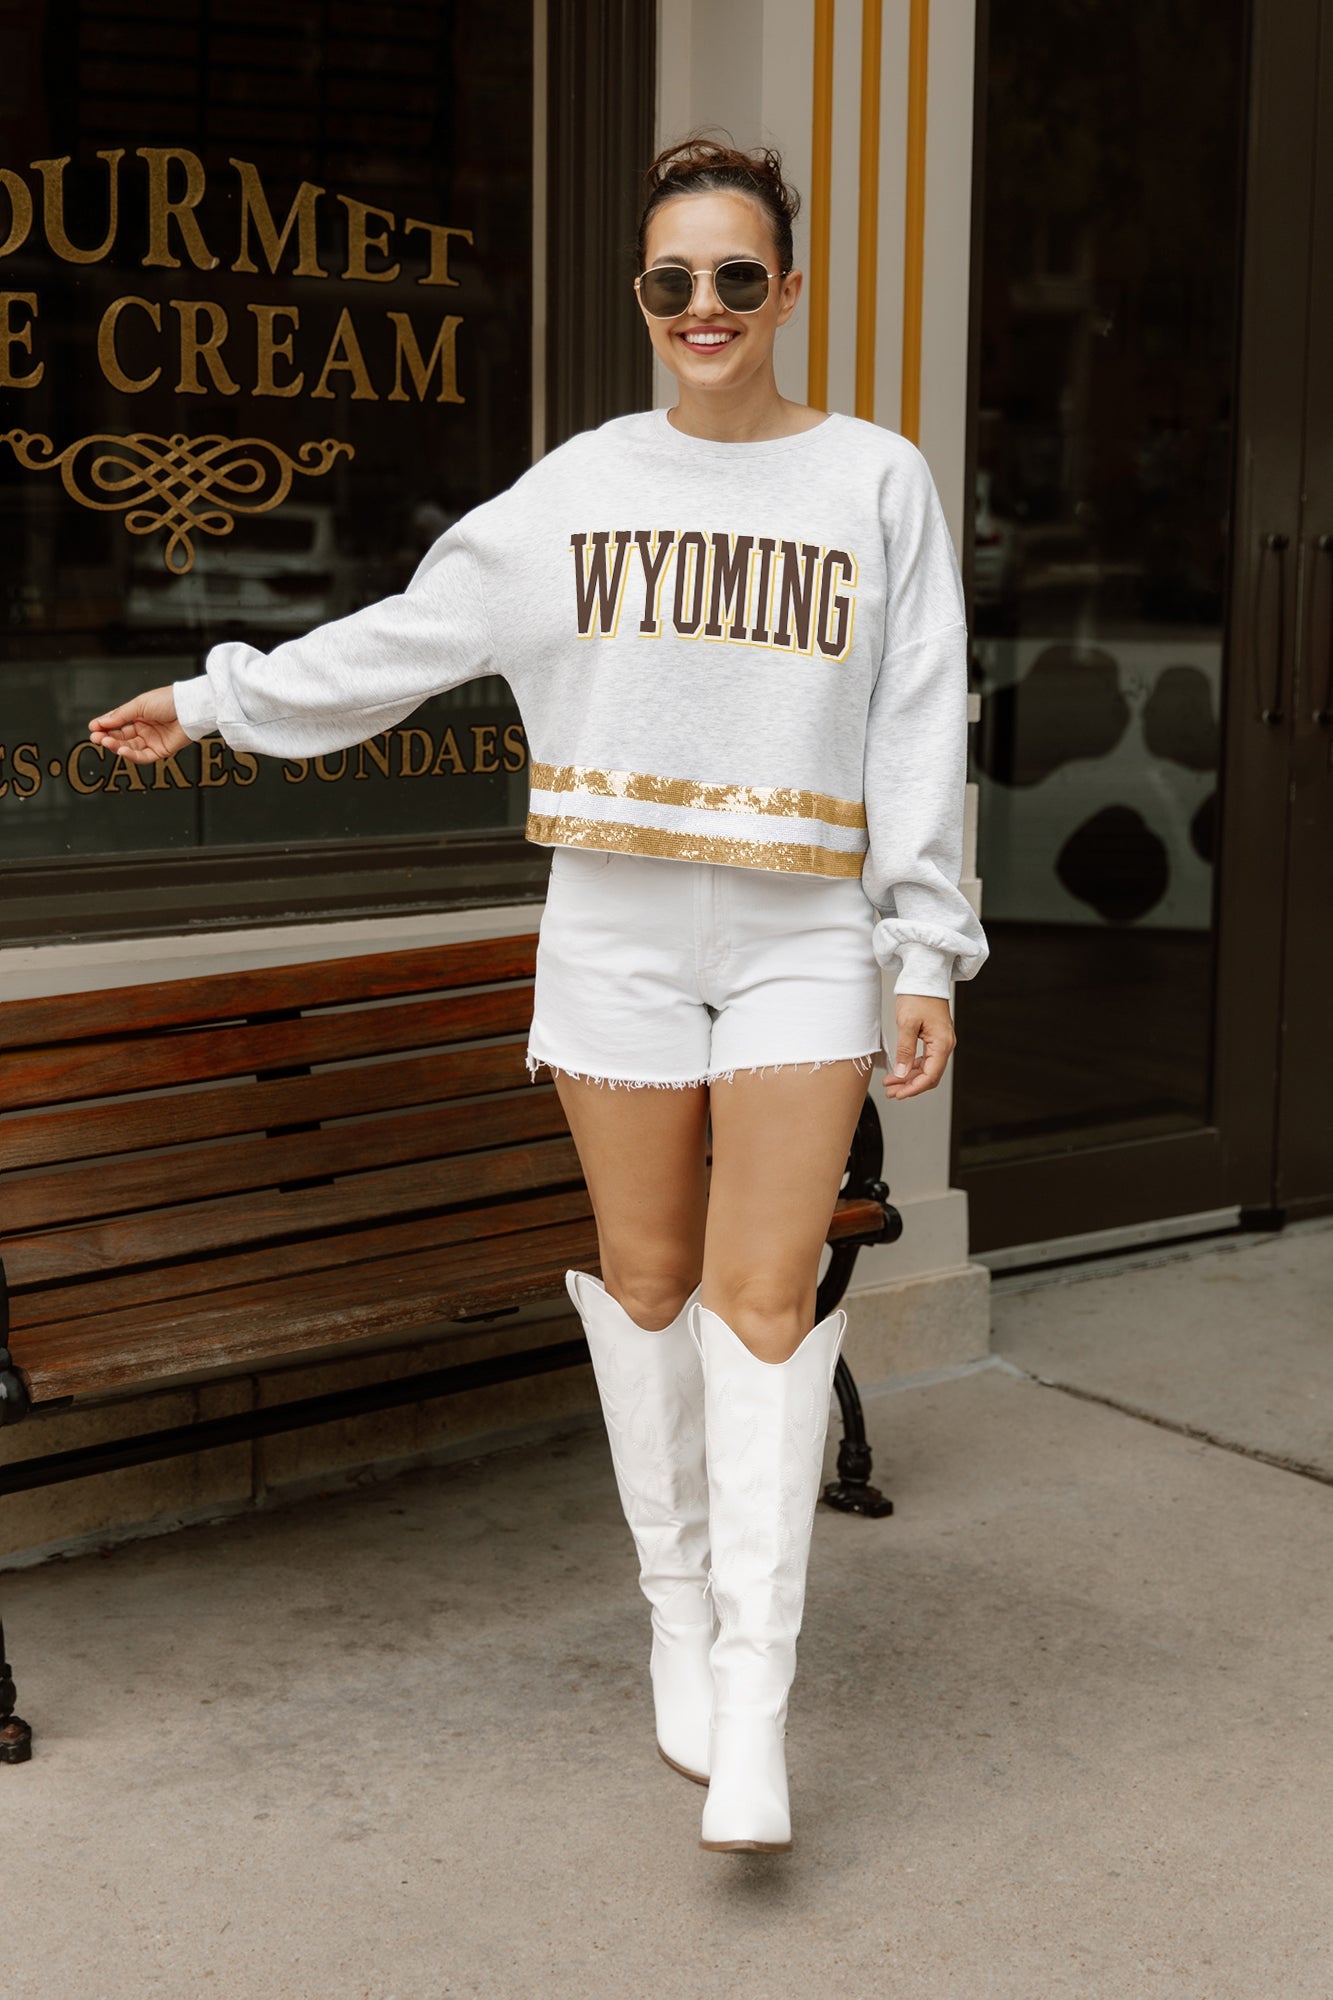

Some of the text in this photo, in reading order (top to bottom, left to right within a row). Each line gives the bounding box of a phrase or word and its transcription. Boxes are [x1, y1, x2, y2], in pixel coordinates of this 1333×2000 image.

[97, 295, 466, 404] CREAM
[569, 529, 859, 662] WYOMING
[67, 738, 259, 794] CAKES
